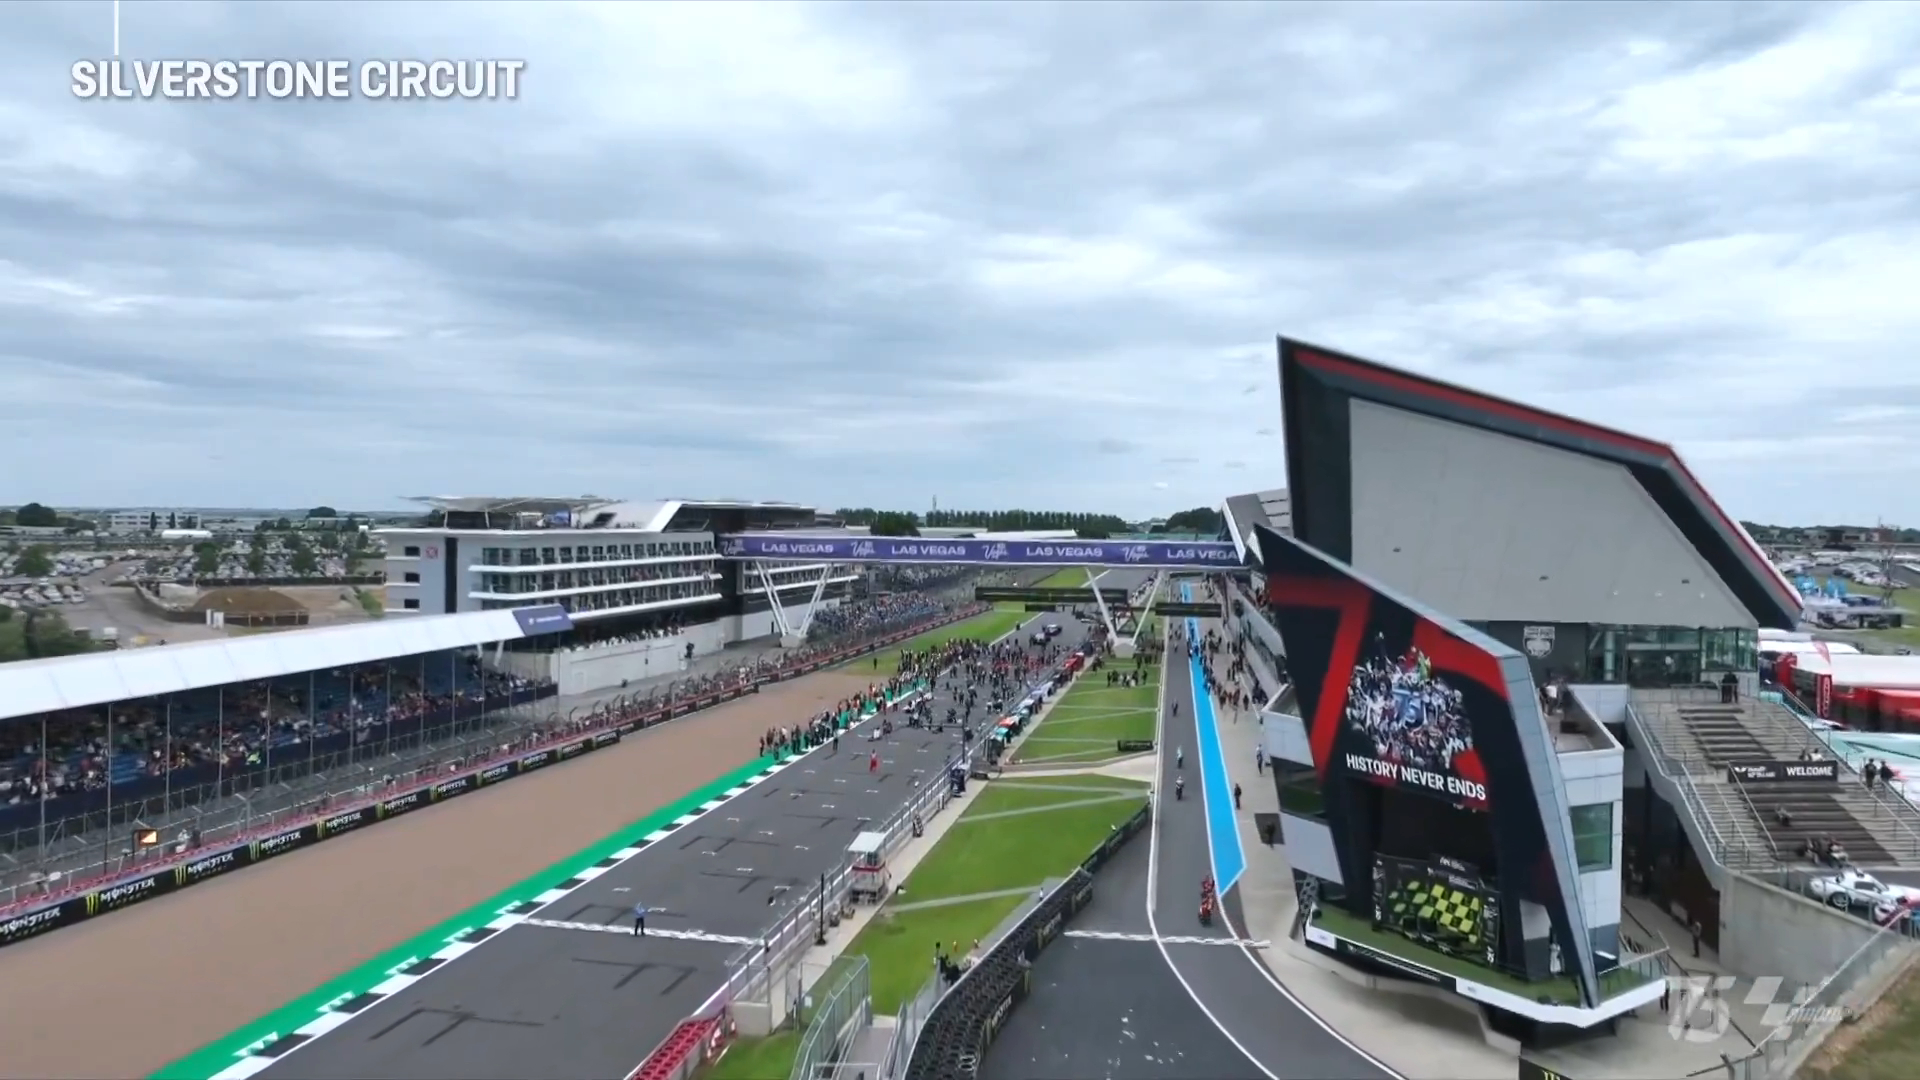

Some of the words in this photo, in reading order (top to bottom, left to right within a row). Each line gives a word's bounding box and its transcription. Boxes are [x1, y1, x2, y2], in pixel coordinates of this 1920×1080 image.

[761, 543, 788, 553] LAS
[790, 544, 834, 554] VEGAS
[891, 543, 917, 555] LAS
[921, 545, 966, 556] VEGAS
[1026, 546, 1053, 557] LAS
[1057, 547, 1103, 557] VEGAS
[1167, 548, 1195, 559] LAS
[1198, 550, 1237, 560] VEGA
[1345, 753, 1398, 780] HISTORY
[1400, 766, 1444, 792] NEVER
[1447, 776, 1486, 801] ENDS
[1786, 766, 1833, 776] WELCOME
[187, 852, 234, 874] MONSTER
[100, 877, 155, 902] MONSTER
[0, 906, 61, 933] MONSTER
